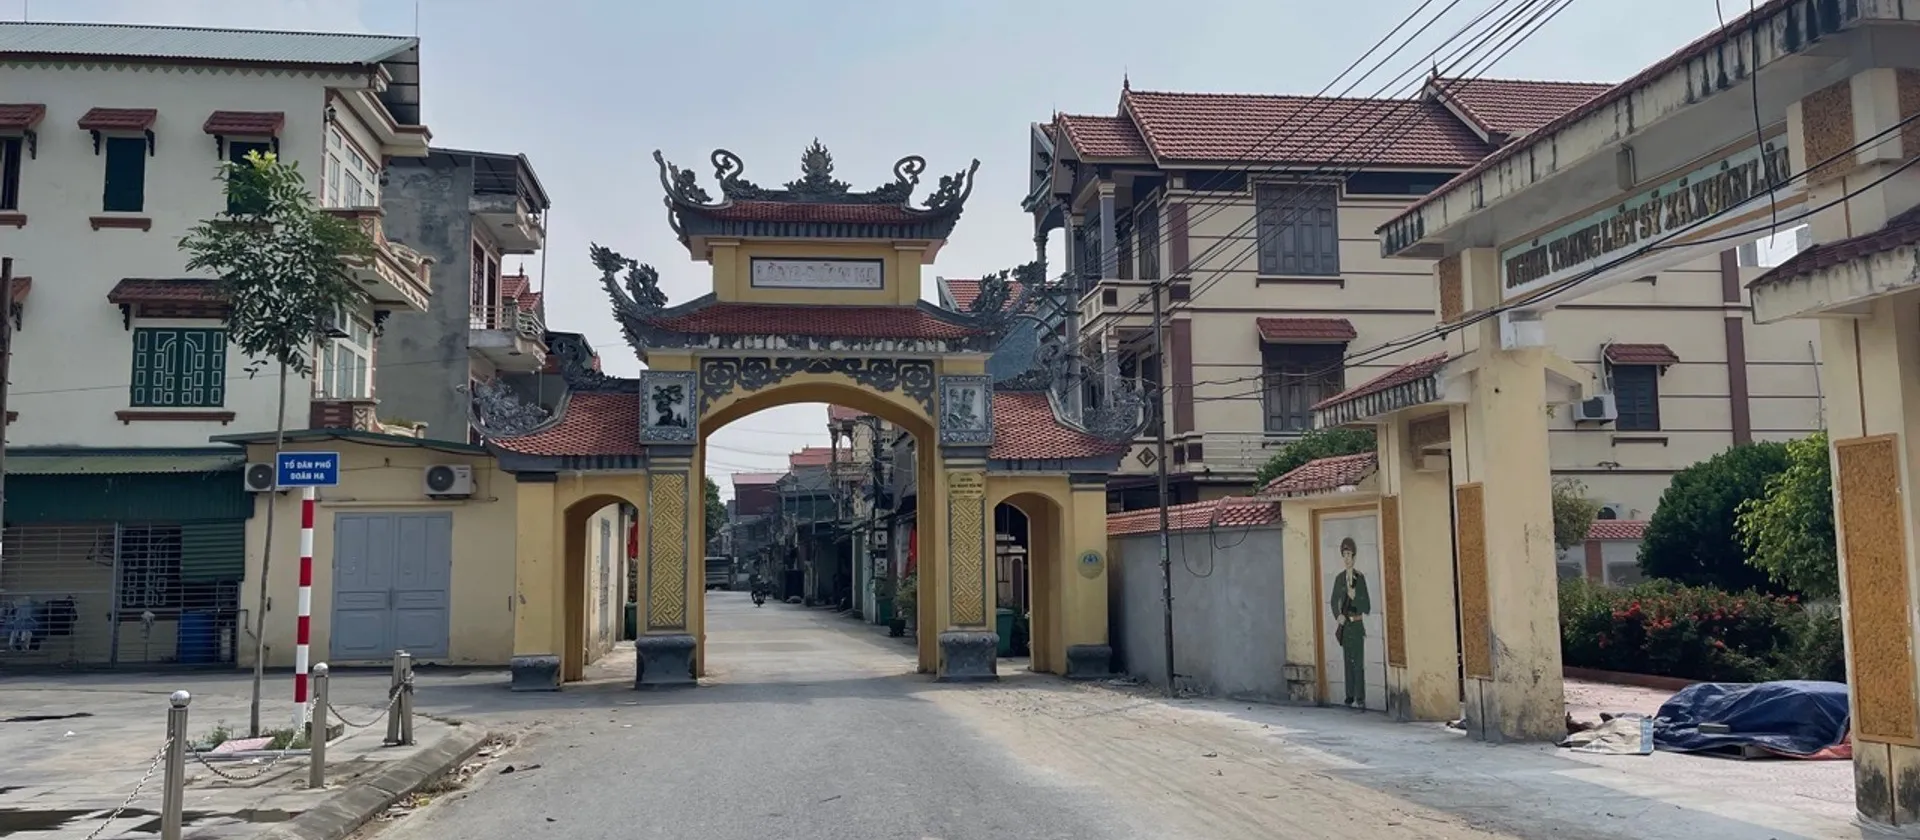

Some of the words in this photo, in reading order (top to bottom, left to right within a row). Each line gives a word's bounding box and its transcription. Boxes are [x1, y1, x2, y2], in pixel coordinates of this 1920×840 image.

[1506, 238, 1550, 289] NGHĨA
[1549, 223, 1601, 272] TRANG
[1664, 177, 1693, 230] XÃ
[1691, 160, 1748, 219] XUÂN
[297, 460, 313, 469] DÂN
[315, 459, 331, 469] PHỐ
